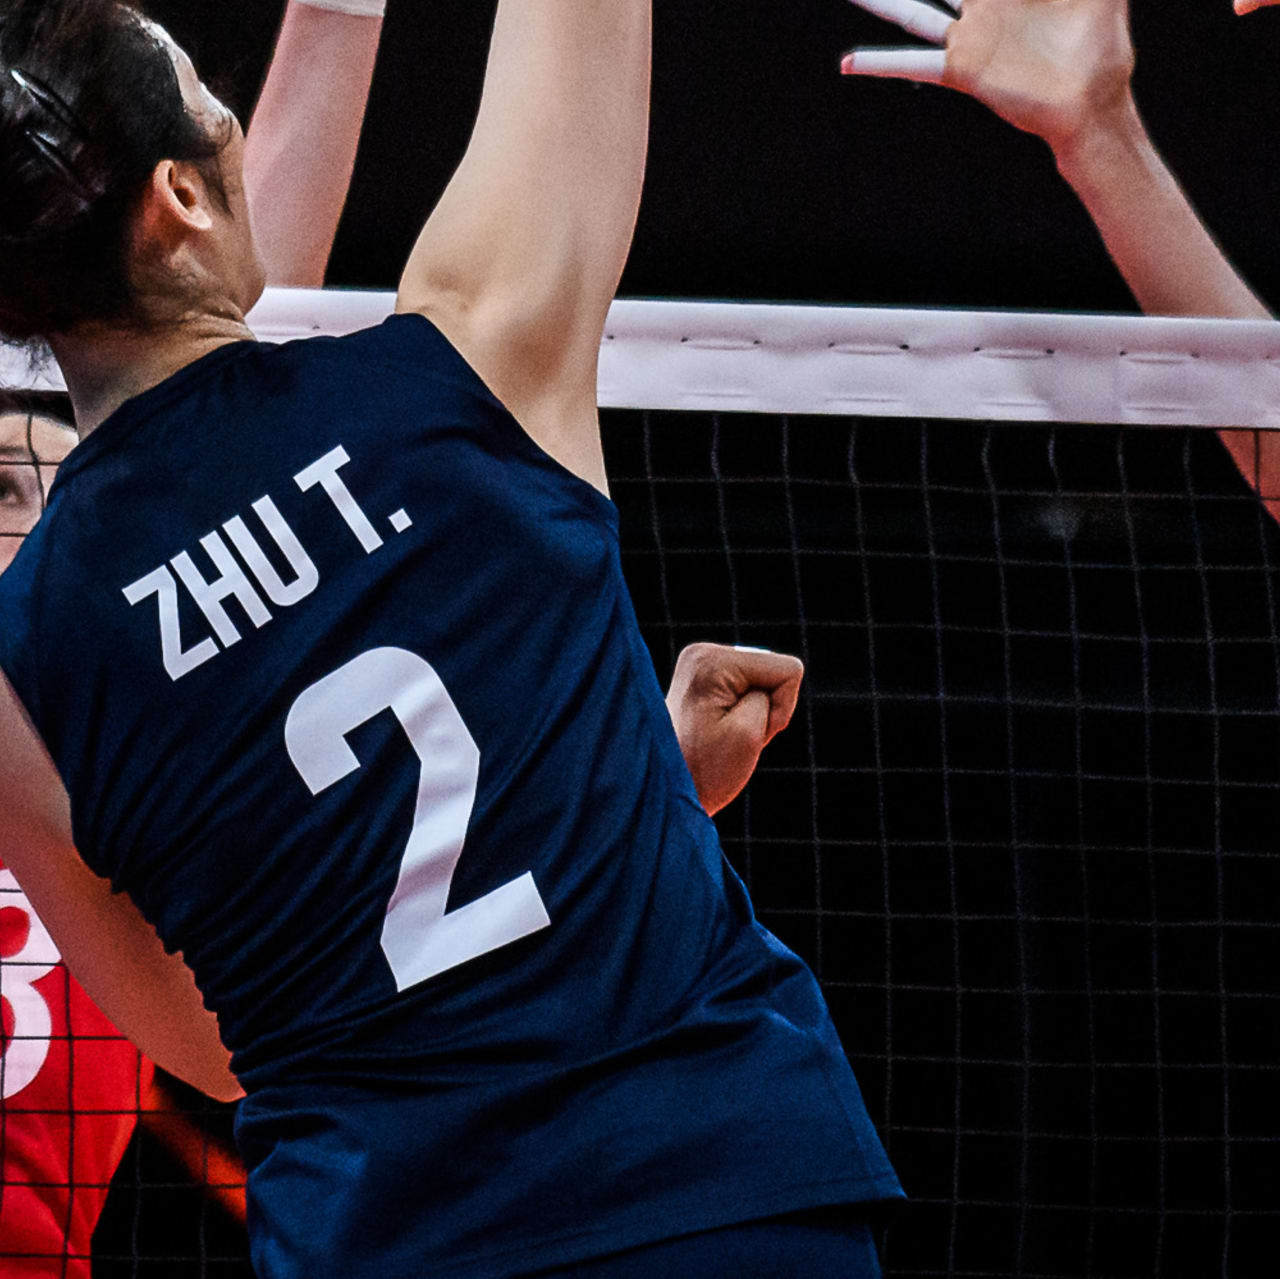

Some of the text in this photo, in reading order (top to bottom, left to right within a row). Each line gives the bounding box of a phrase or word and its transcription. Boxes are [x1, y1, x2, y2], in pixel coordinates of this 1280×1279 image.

[122, 444, 413, 681] ZHU T.
[284, 646, 551, 992] 2
